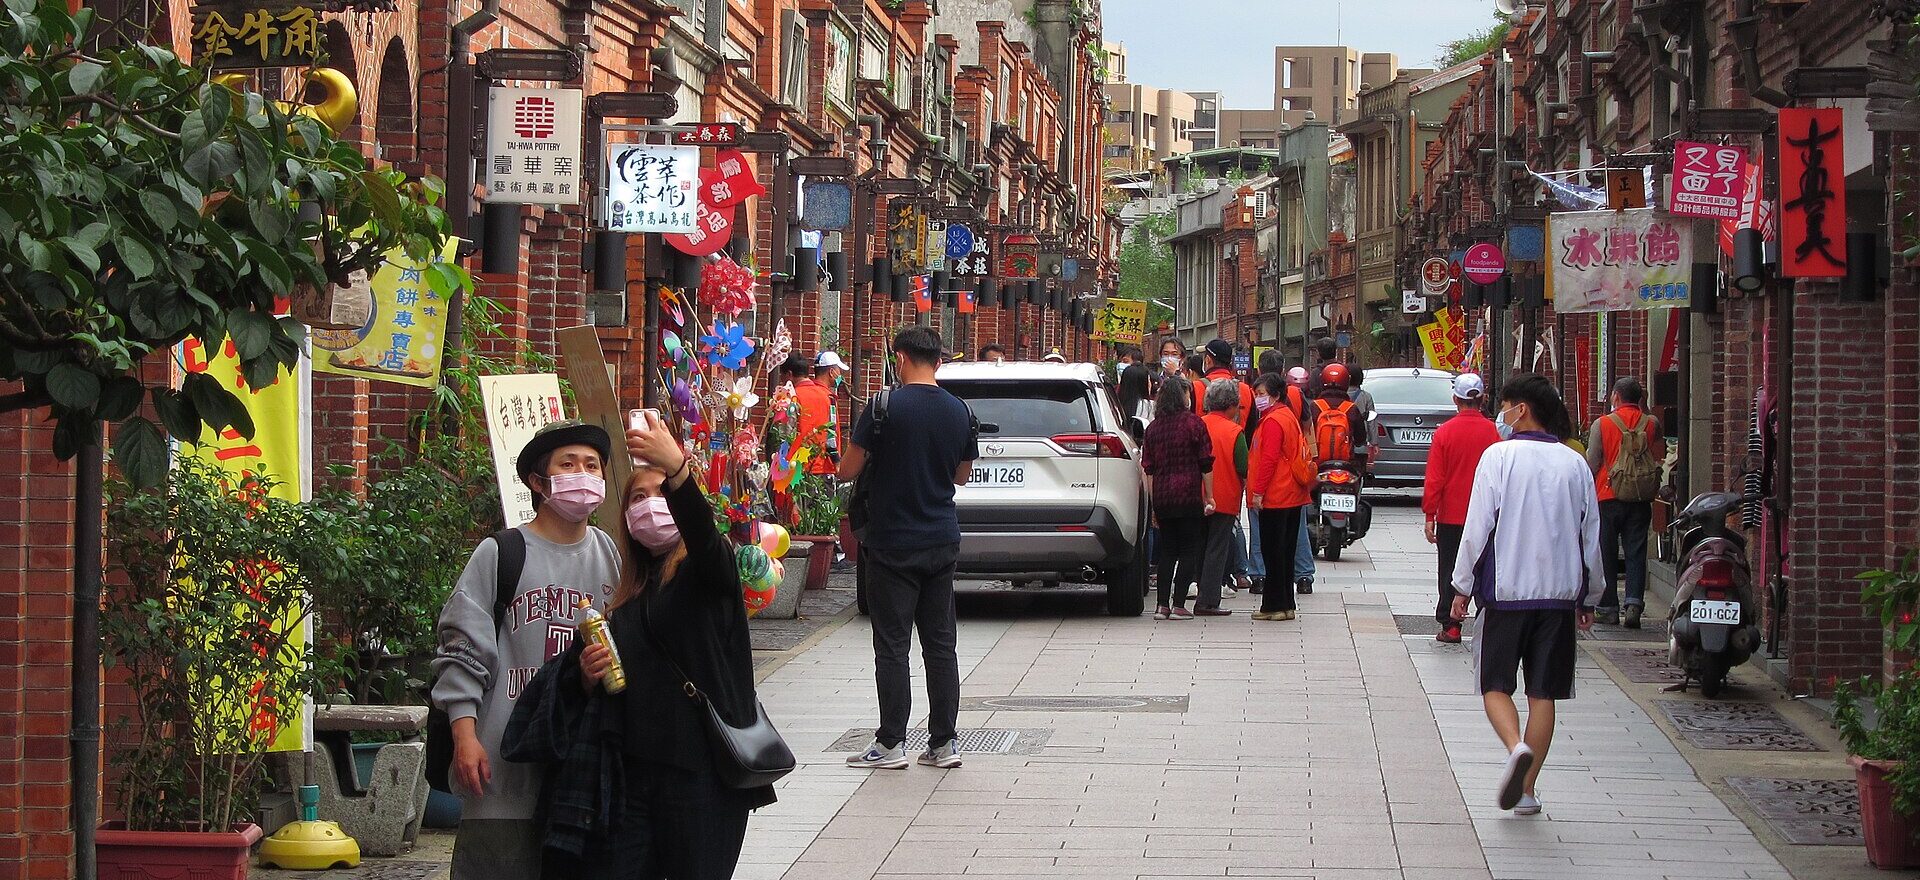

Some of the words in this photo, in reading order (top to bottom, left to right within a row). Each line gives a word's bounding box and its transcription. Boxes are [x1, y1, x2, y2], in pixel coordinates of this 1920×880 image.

[192, 6, 318, 60] 金牛角
[534, 142, 561, 151] POTTERY
[494, 155, 572, 176] 臺華窯
[1685, 146, 1740, 172] 又見
[494, 180, 570, 194] 藝術典藏館
[1681, 168, 1739, 195] 面了
[1673, 203, 1739, 217] 設計師品牌服飾
[1564, 223, 1680, 269] 水果飴
